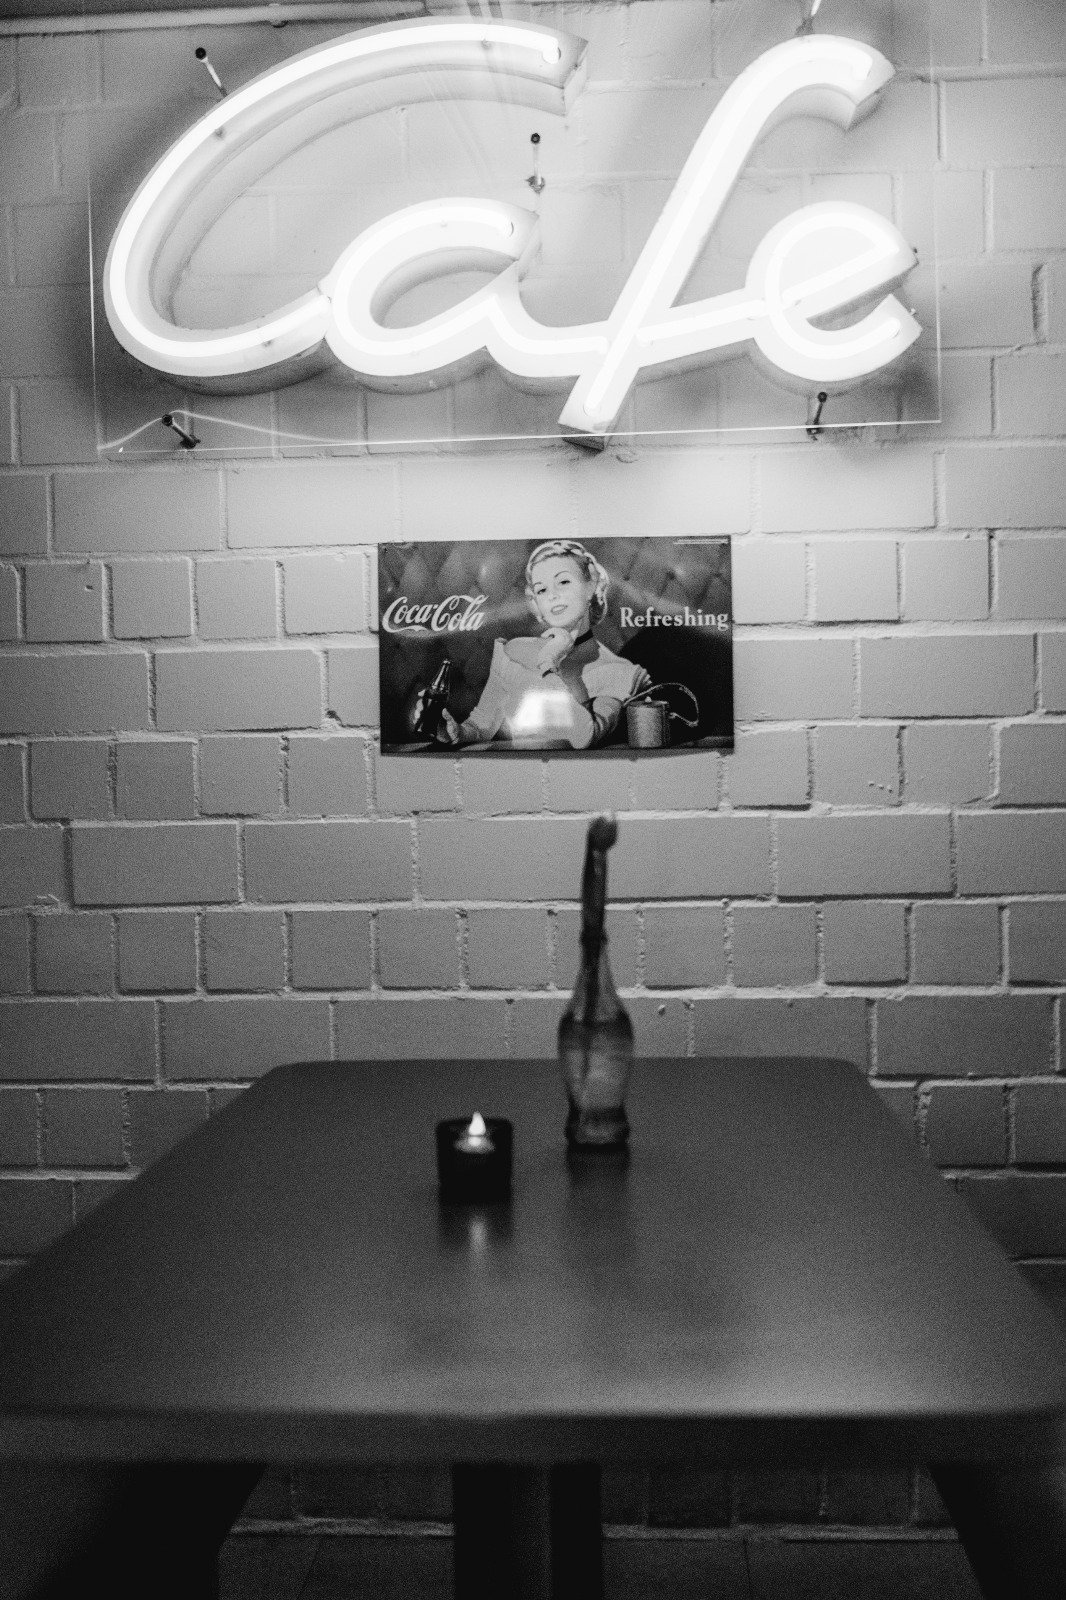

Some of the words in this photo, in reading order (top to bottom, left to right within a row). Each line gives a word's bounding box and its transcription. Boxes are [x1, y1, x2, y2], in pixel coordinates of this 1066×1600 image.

[103, 17, 922, 434] Cafe
[382, 594, 489, 633] Coca-Cola
[619, 606, 729, 630] Refreshing
